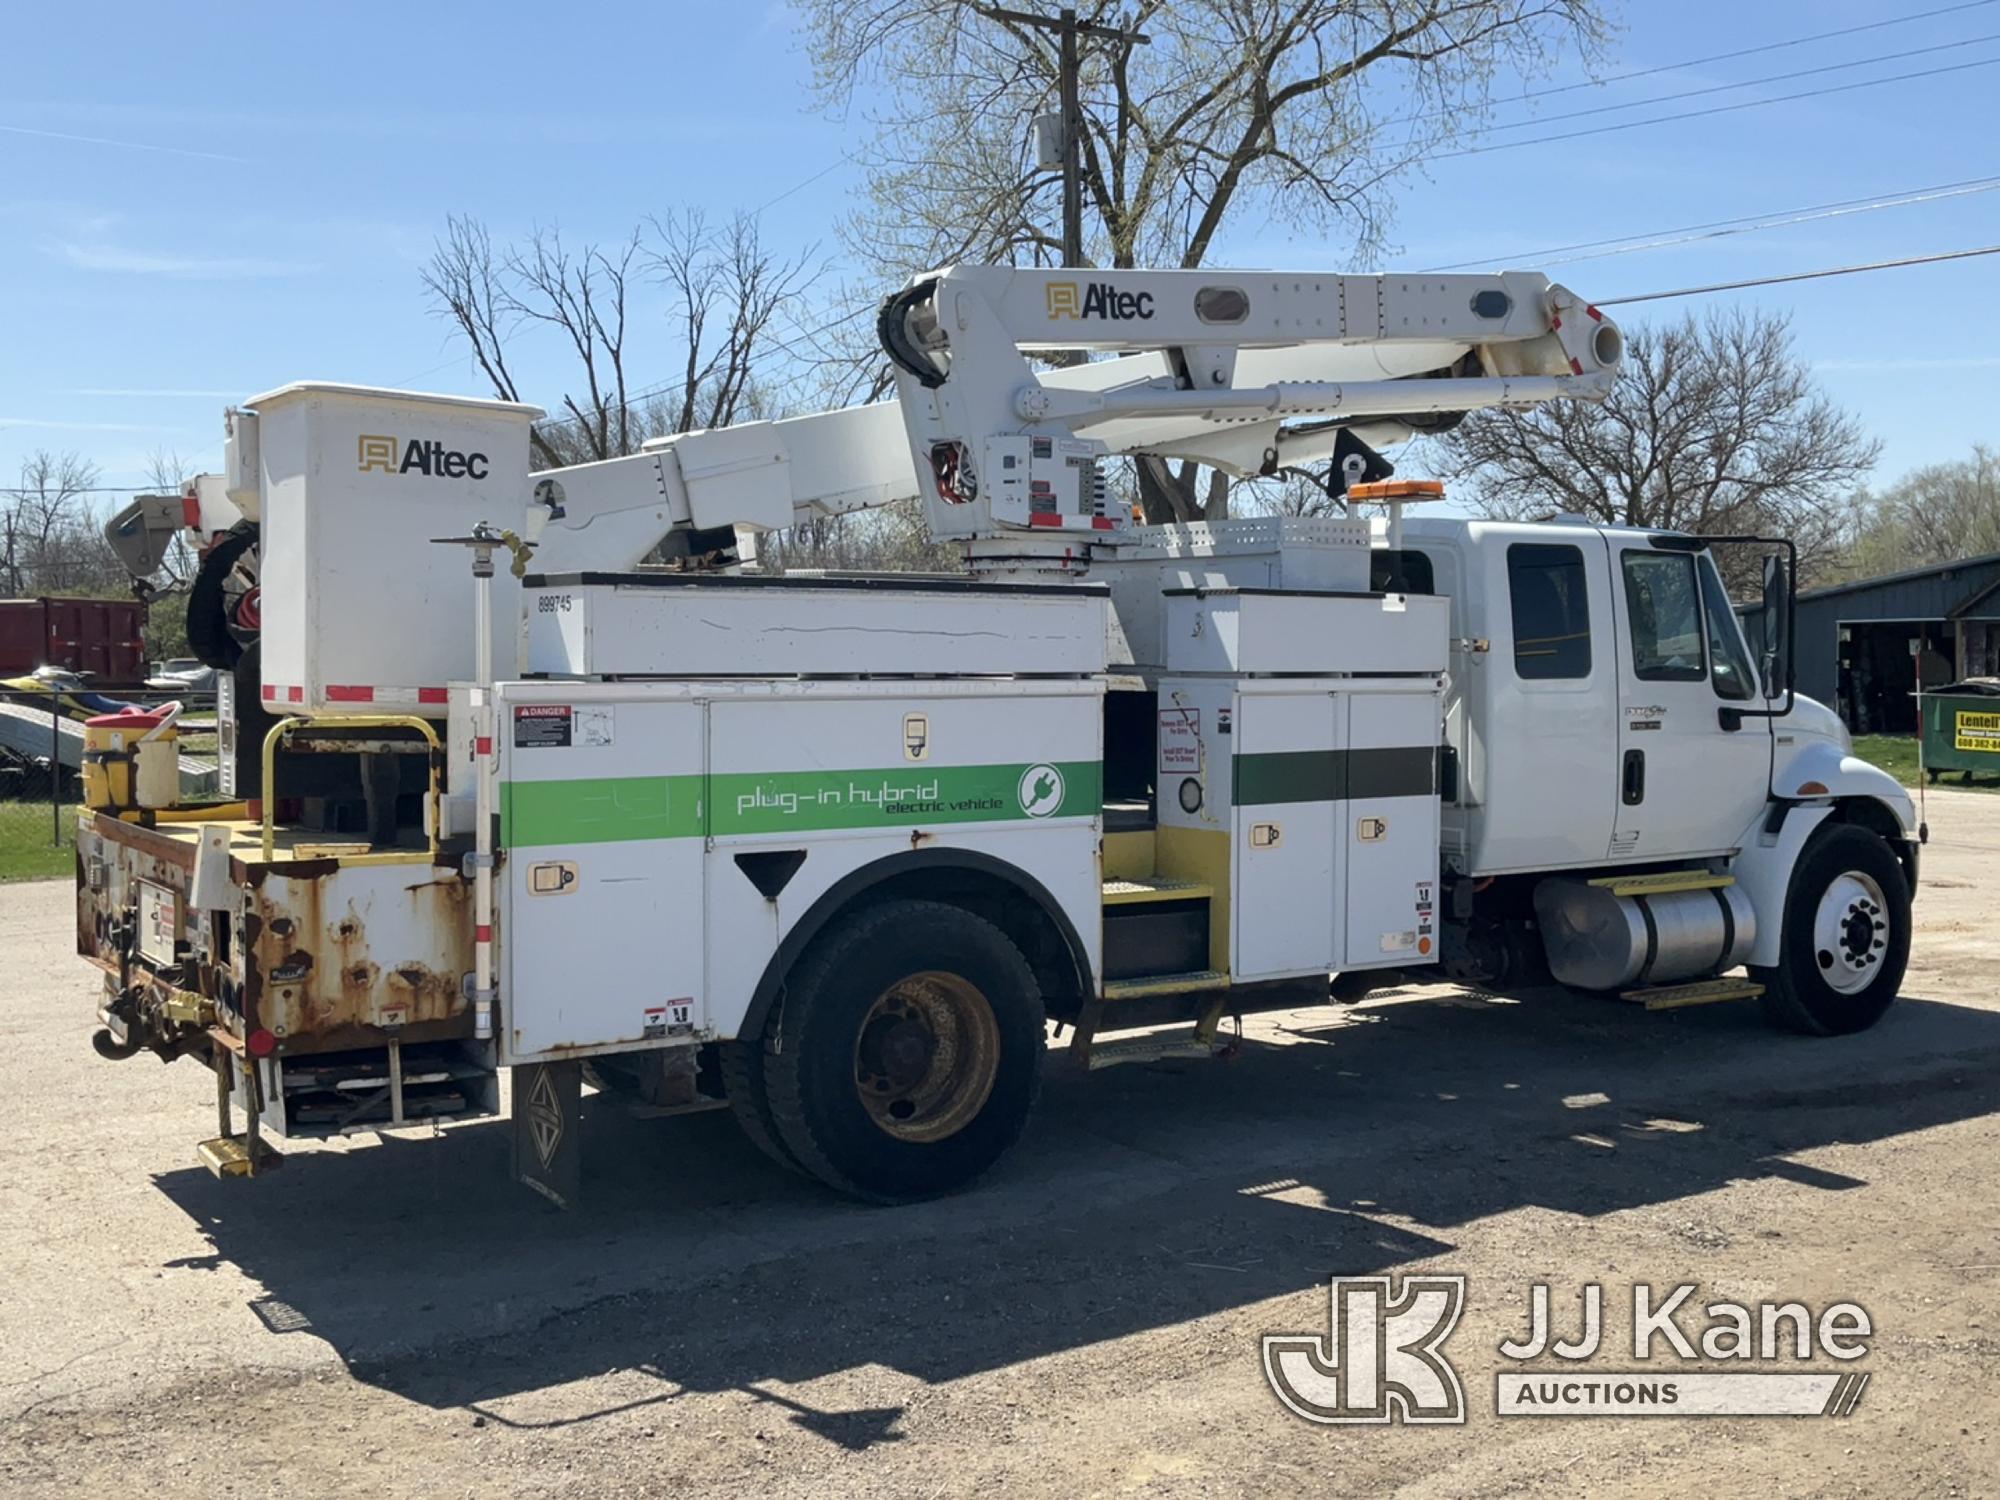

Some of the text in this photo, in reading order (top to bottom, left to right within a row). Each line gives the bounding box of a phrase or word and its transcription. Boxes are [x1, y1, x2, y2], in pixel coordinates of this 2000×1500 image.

[1081, 283, 1155, 320] Altec
[399, 439, 490, 480] Altec
[538, 595, 572, 613] 899745
[529, 707, 567, 717] DANGER
[737, 778, 938, 816] plug-in hybrid
[885, 797, 1004, 815] electric vehicle
